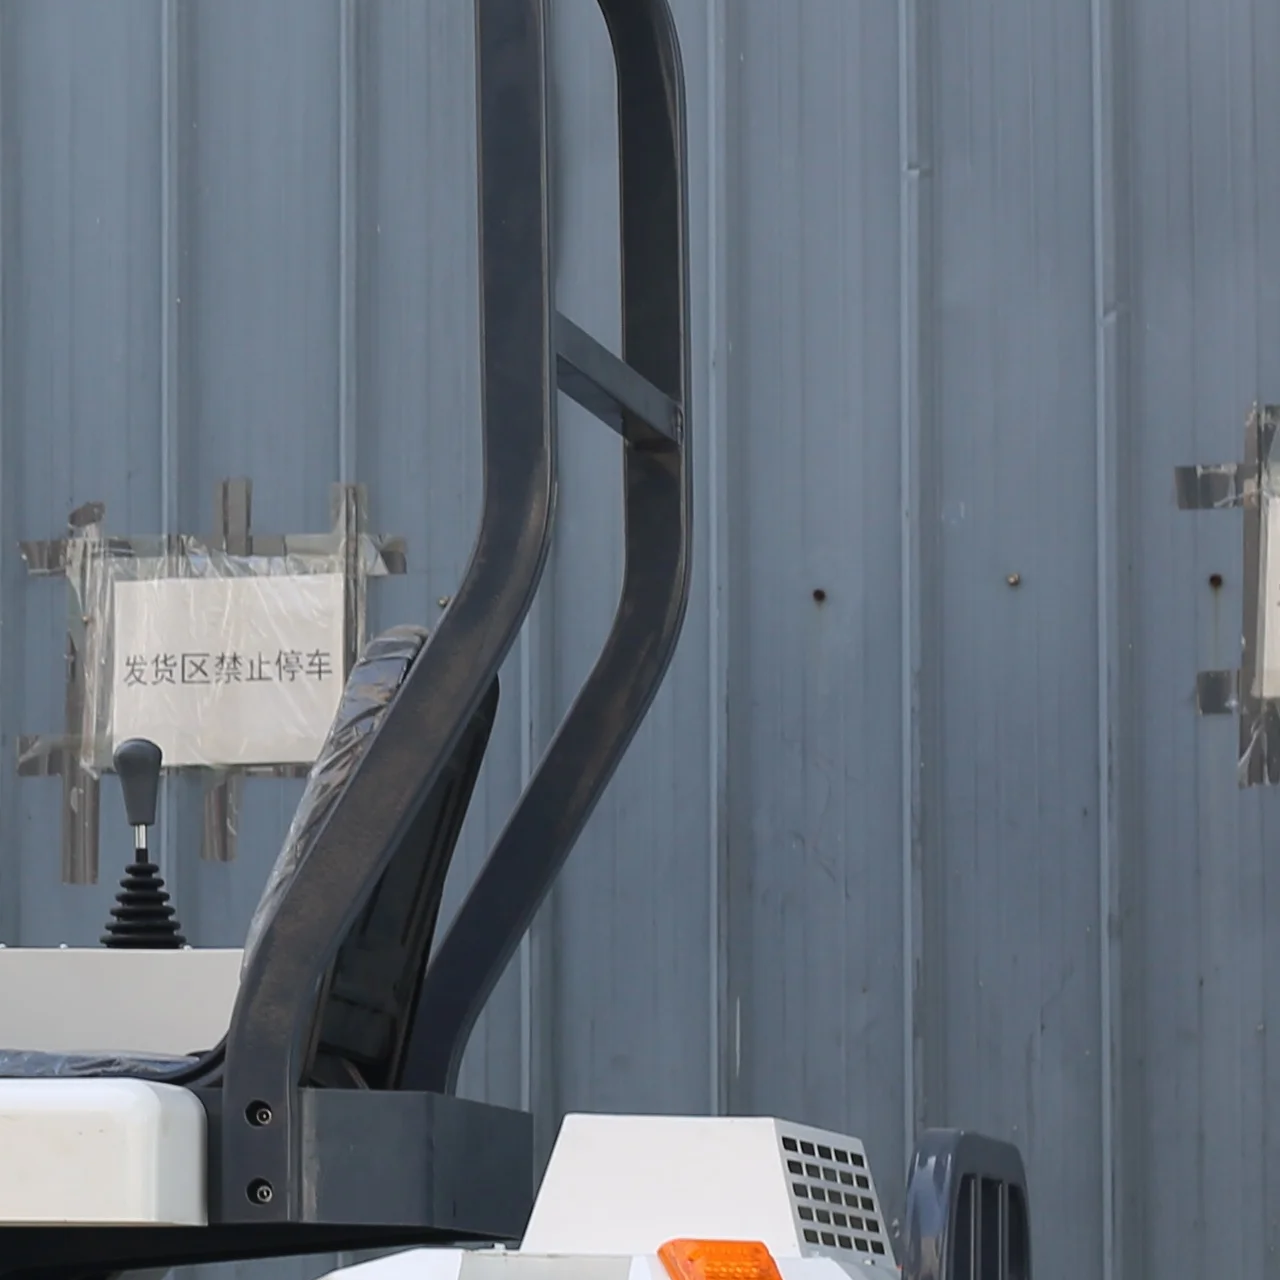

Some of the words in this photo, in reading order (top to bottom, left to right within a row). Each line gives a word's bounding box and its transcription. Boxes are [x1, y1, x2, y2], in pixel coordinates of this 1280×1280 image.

[123, 648, 334, 686] 发货区禁止停车
